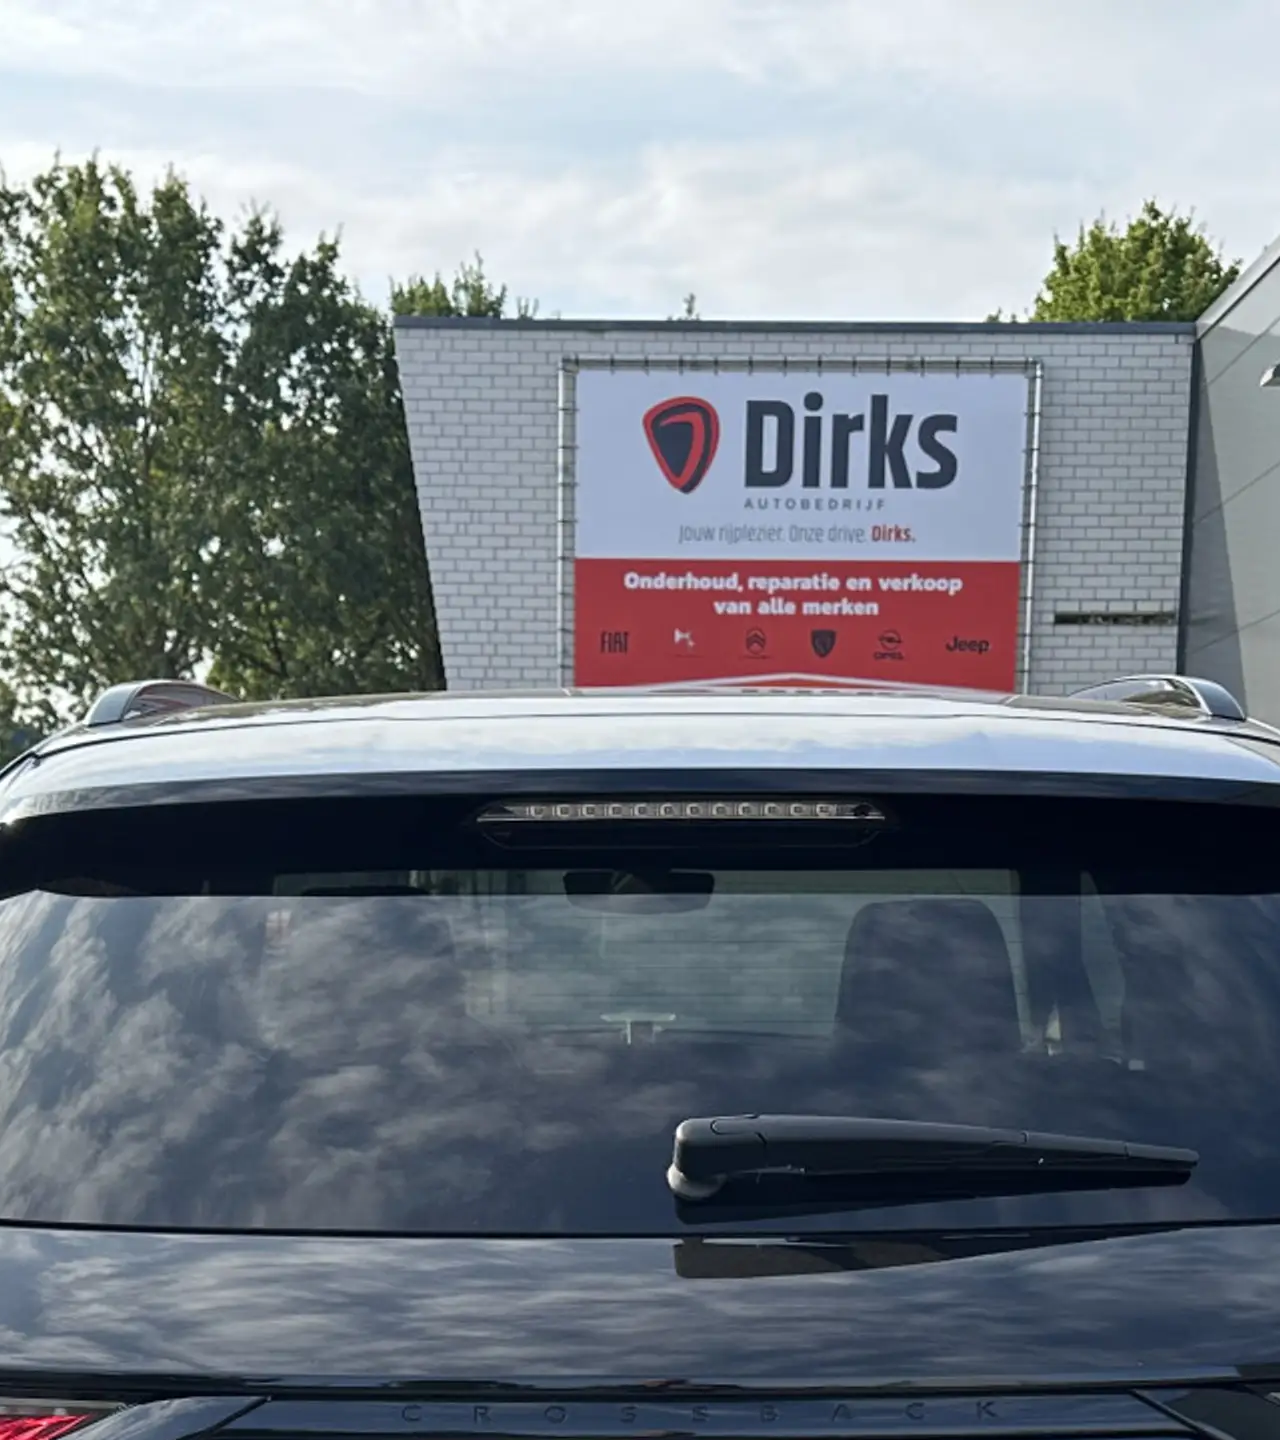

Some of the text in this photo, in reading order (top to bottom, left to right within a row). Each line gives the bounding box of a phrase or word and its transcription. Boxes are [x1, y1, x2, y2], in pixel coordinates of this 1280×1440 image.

[744, 391, 958, 490] Dirks
[743, 498, 886, 511] AUTOBEDRIJF
[678, 524, 715, 544] Jouw
[789, 526, 824, 543] Onze
[871, 525, 916, 543] Dirks.
[624, 572, 963, 596] Onderhoud, reparatie en verkoop
[714, 597, 879, 616] van alle merken
[600, 631, 629, 654] FIAT
[946, 636, 990, 654] Jeep
[401, 1400, 999, 1425] CROSSBACK
